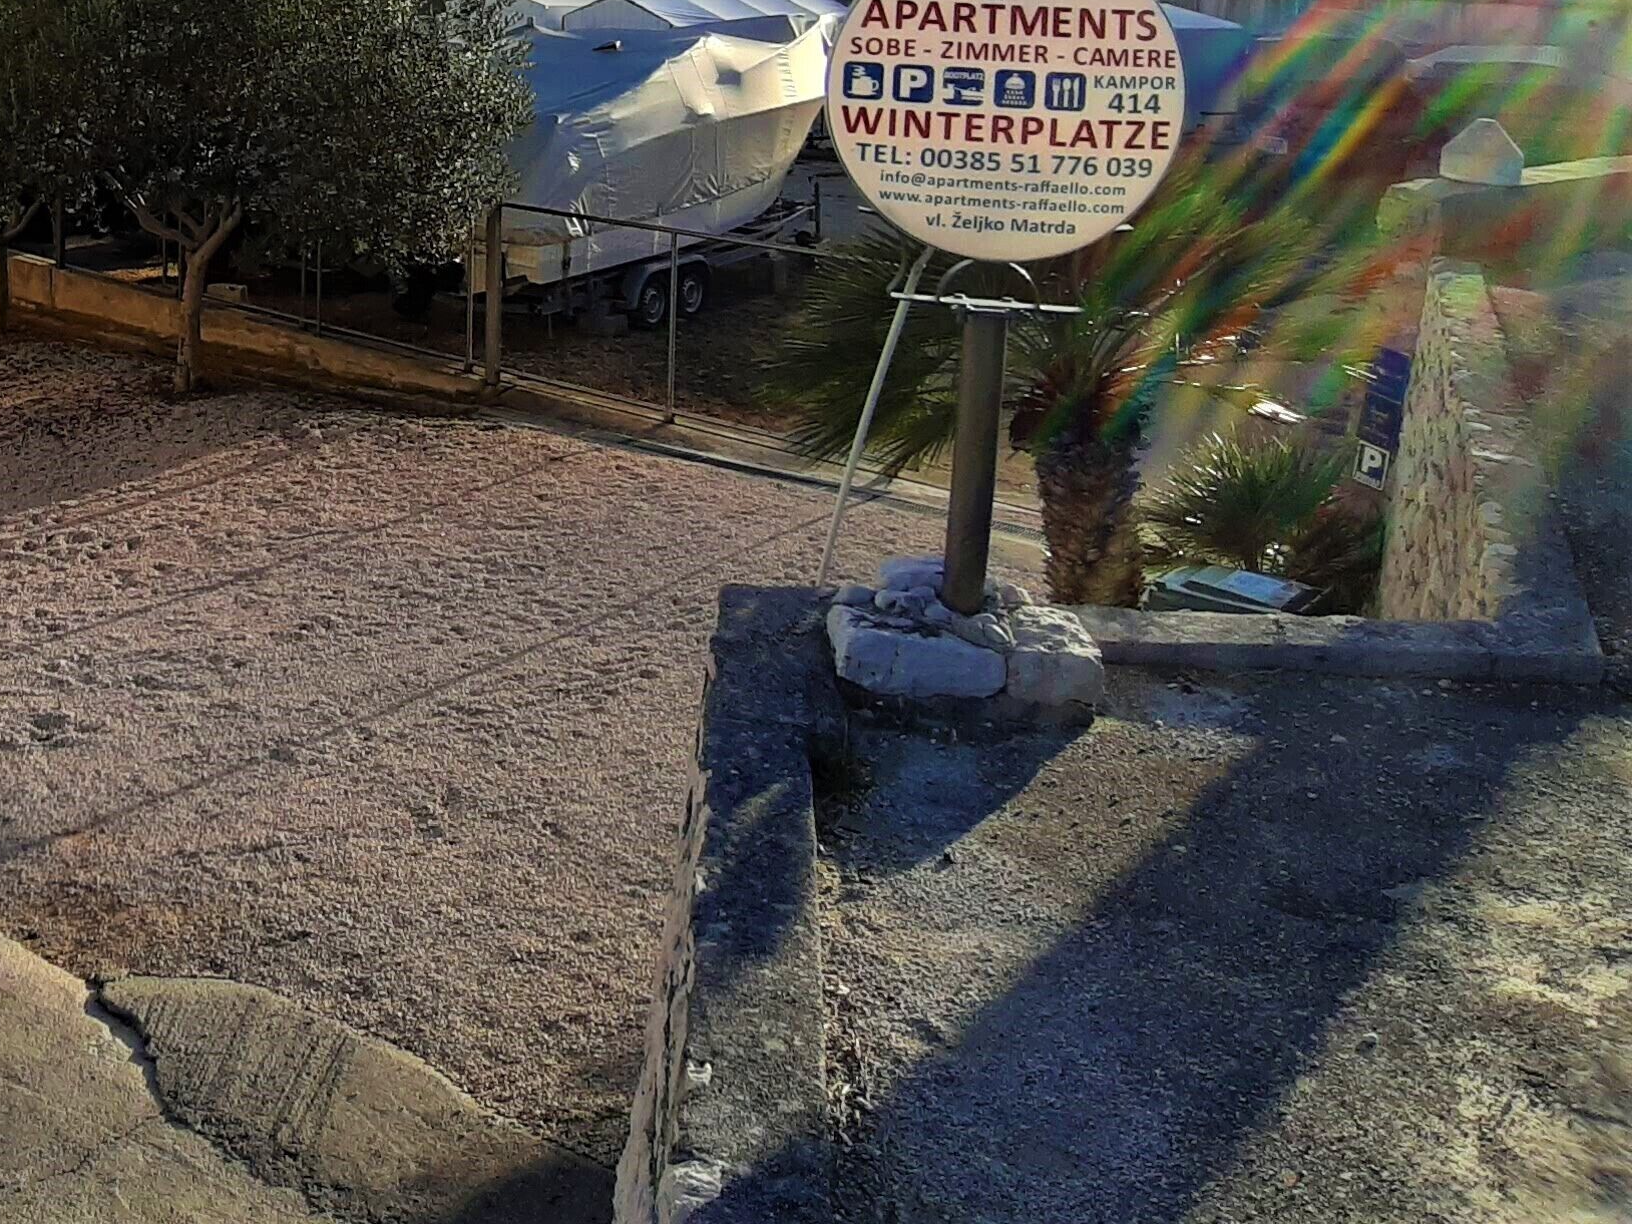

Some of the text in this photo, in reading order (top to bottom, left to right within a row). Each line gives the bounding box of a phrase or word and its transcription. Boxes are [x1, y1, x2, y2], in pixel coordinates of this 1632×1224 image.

[850, 36, 917, 58] SOBE
[941, 40, 1049, 64] ZIMMER
[1073, 46, 1176, 69] CAMERE
[899, 68, 928, 98] P
[1094, 75, 1176, 91] KAMPOR
[1108, 93, 1161, 114] 414
[842, 105, 1171, 150] WINTERPLATZE
[856, 142, 1153, 178] TEL: 00385 51 776 039
[880, 169, 1127, 196] info@apartments-raffaello.com
[879, 189, 1125, 215] www.apartments-raffaello.com
[926, 212, 1076, 235] vl. Željko Matrda
[1361, 446, 1383, 473] P
